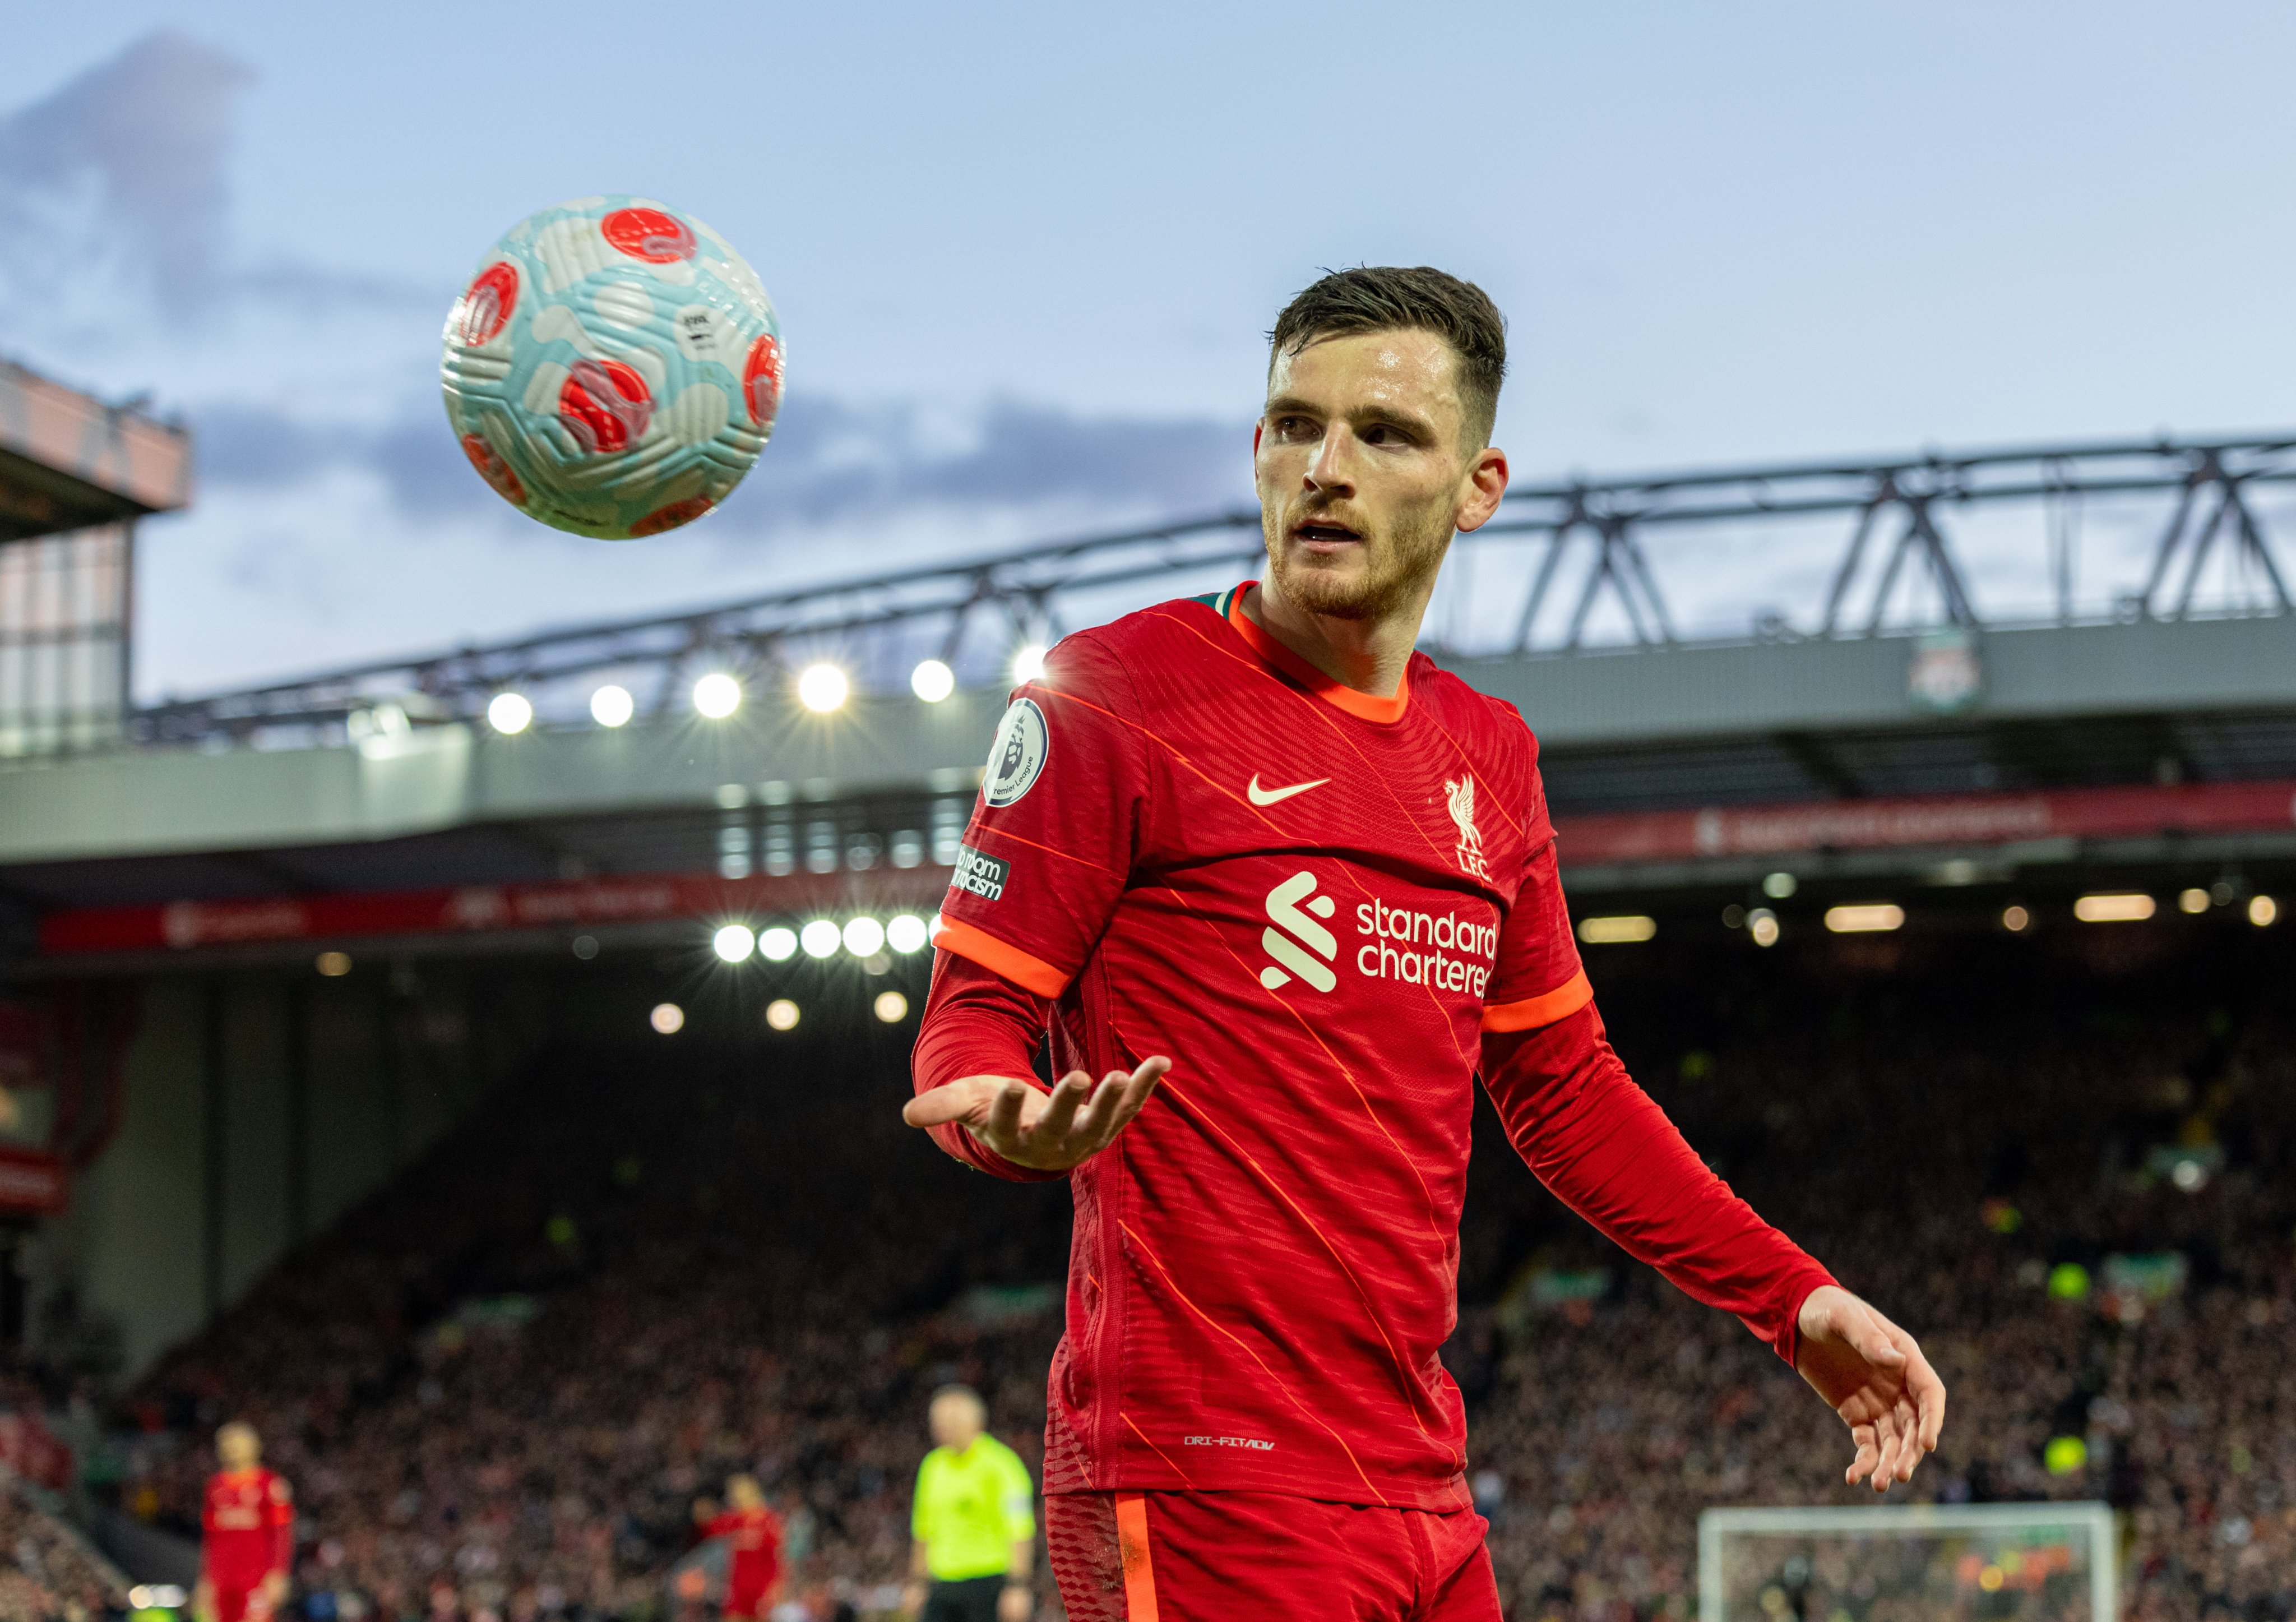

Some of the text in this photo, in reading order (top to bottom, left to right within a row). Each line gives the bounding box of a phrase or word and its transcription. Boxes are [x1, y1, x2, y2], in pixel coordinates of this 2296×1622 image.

[993, 756, 1034, 795] remier League
[964, 853, 1001, 881] room
[1456, 851, 1493, 882] L.F.C.
[956, 870, 1002, 901] racism
[1357, 898, 1496, 960] standard
